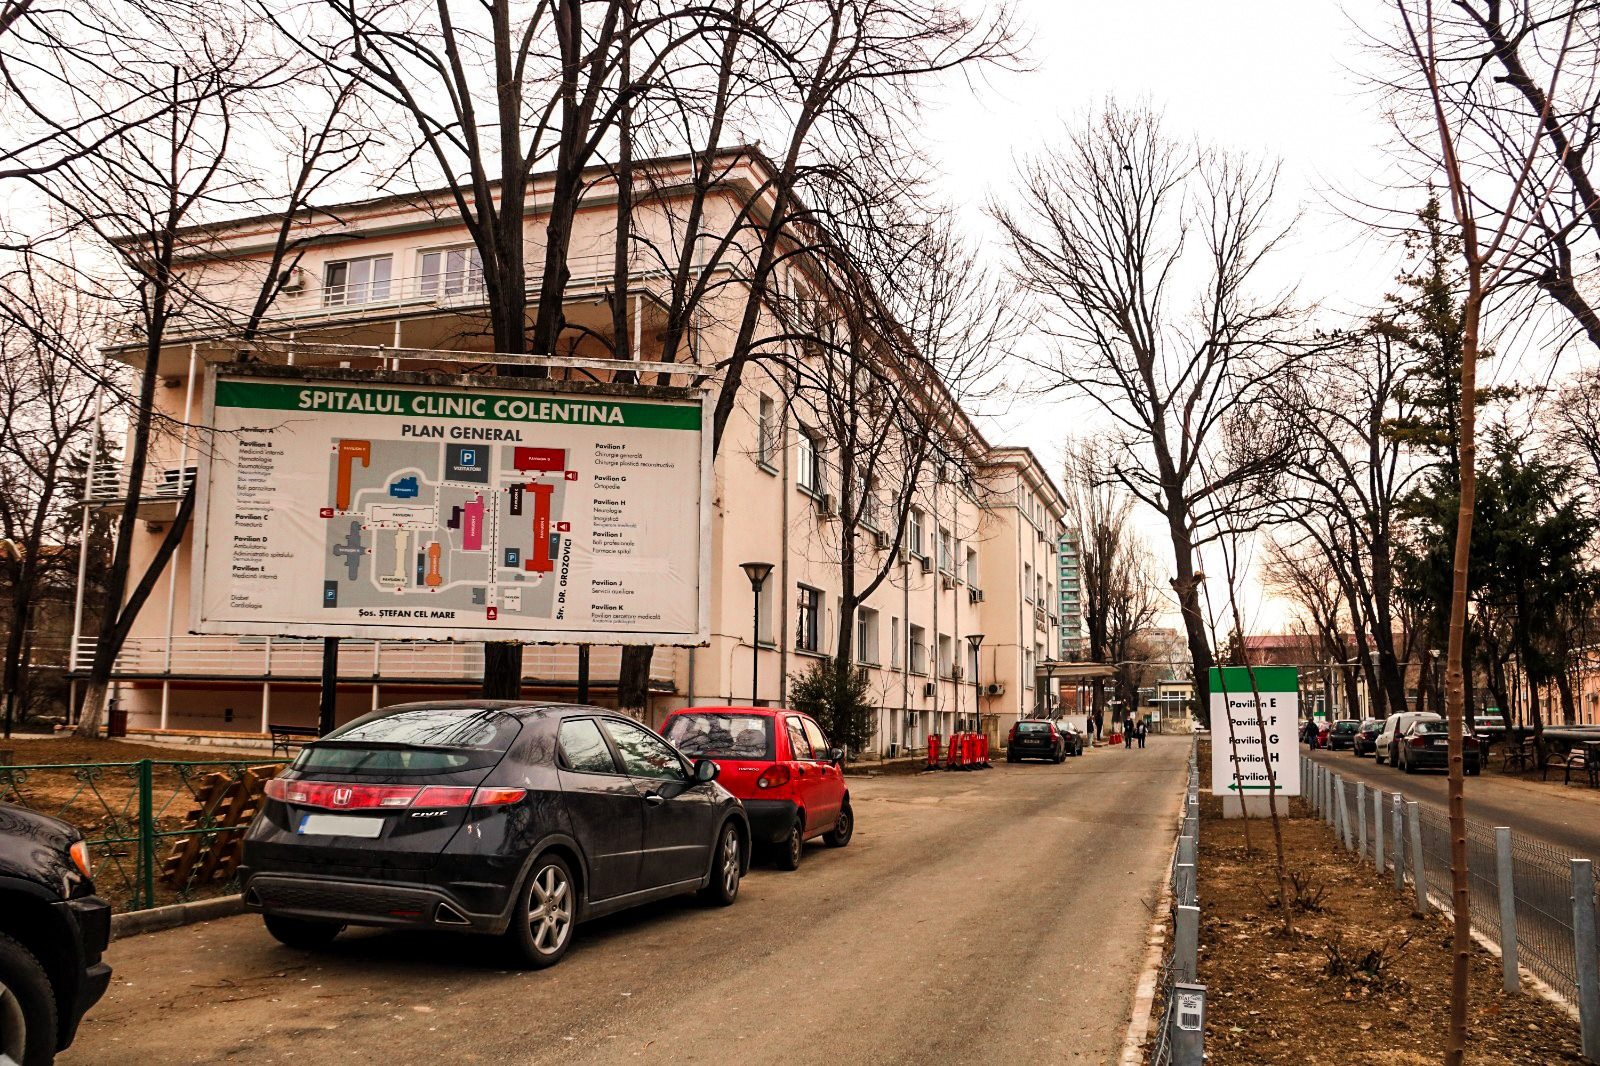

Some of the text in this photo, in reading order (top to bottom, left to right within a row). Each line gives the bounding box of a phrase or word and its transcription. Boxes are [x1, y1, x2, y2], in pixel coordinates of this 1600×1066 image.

[299, 390, 625, 424] SPITALUL CLINIC COLENTINA
[402, 424, 523, 442] PLAN GENERAL
[240, 440, 266, 448] Pavilion
[595, 451, 619, 459] Chirurgie
[594, 459, 619, 467] Chirurgie
[560, 538, 572, 587] GROZOVICI
[558, 589, 567, 603] DR.
[230, 601, 263, 610] Cardiologie
[413, 610, 428, 618] CEL
[432, 611, 455, 619] MARE
[556, 605, 565, 620] Str.
[1229, 698, 1277, 708] Pavilin E
[1270, 716, 1277, 726] F
[1269, 734, 1280, 744] G
[1270, 752, 1279, 762] H
[411, 810, 448, 818] CIVIC
